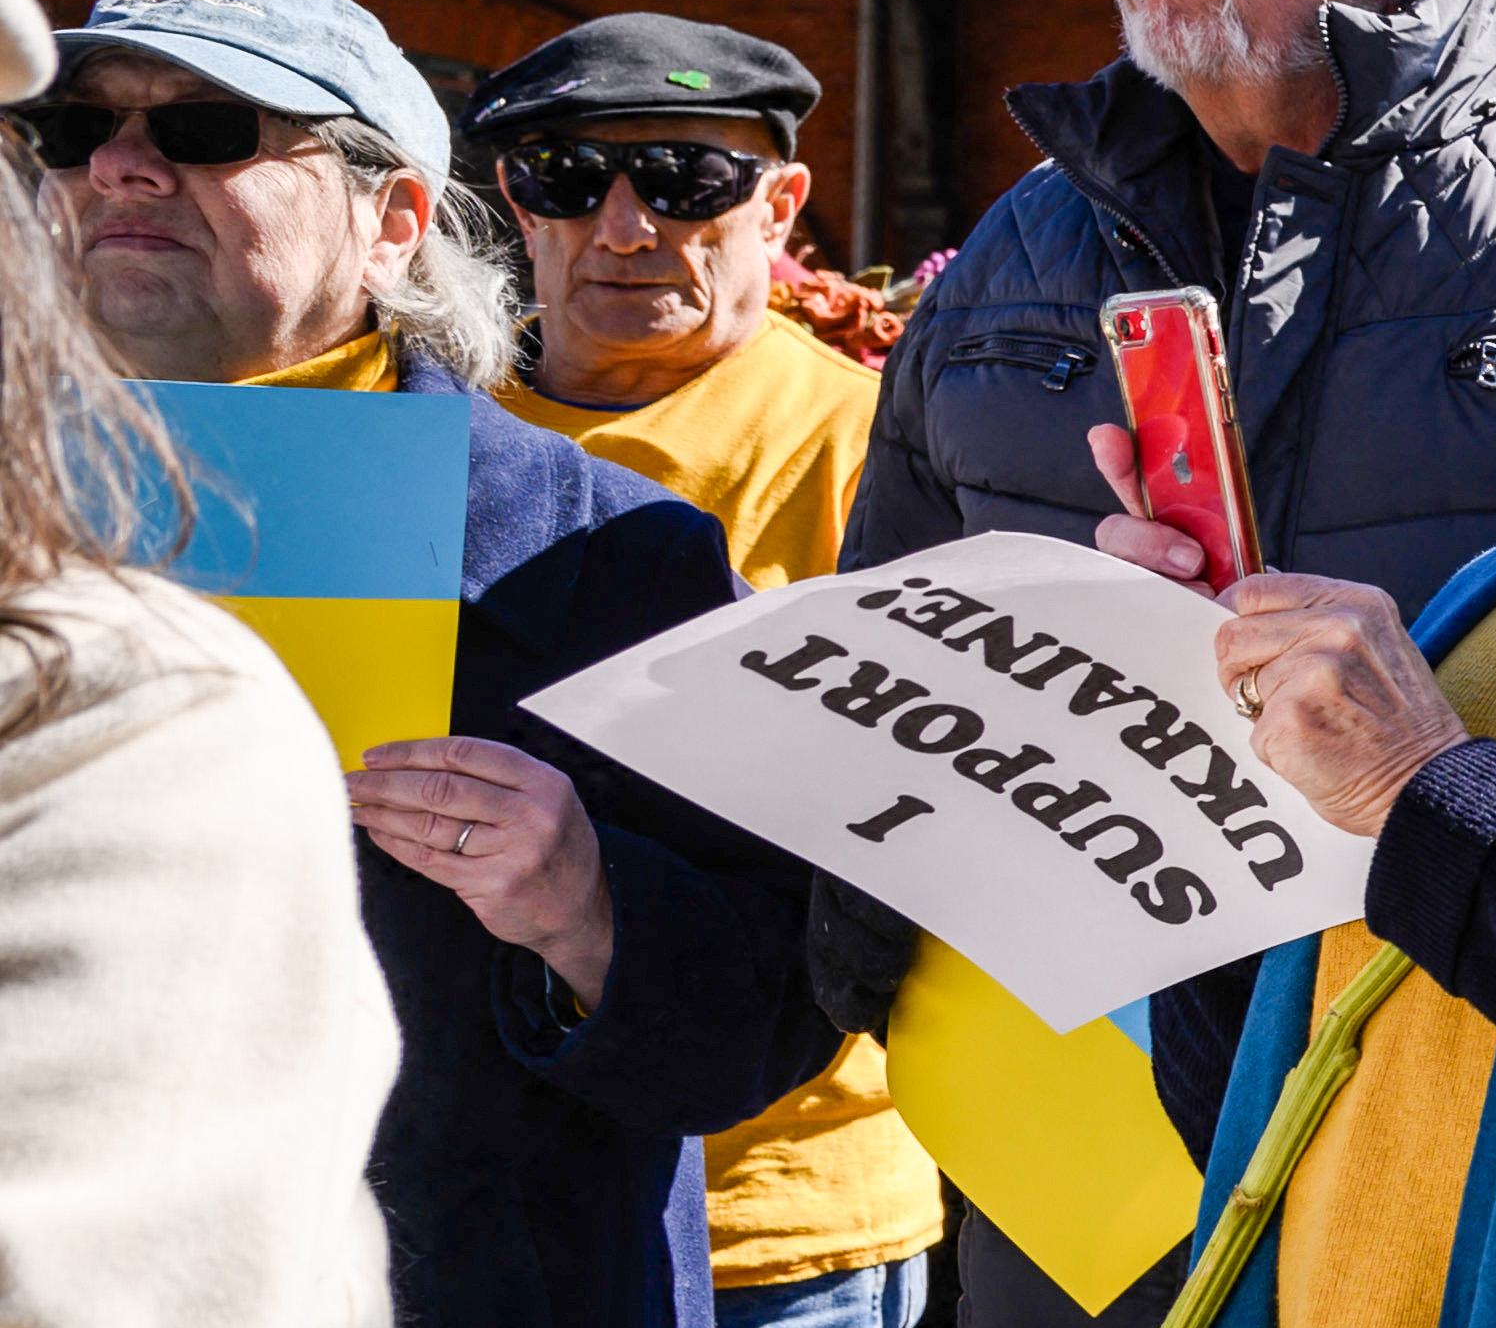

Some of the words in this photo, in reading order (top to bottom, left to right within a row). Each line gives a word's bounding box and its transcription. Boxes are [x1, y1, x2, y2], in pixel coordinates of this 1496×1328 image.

[739, 634, 1218, 925] SUPPORT
[846, 794, 935, 843] I
[857, 577, 1304, 892] UKRAINE!
